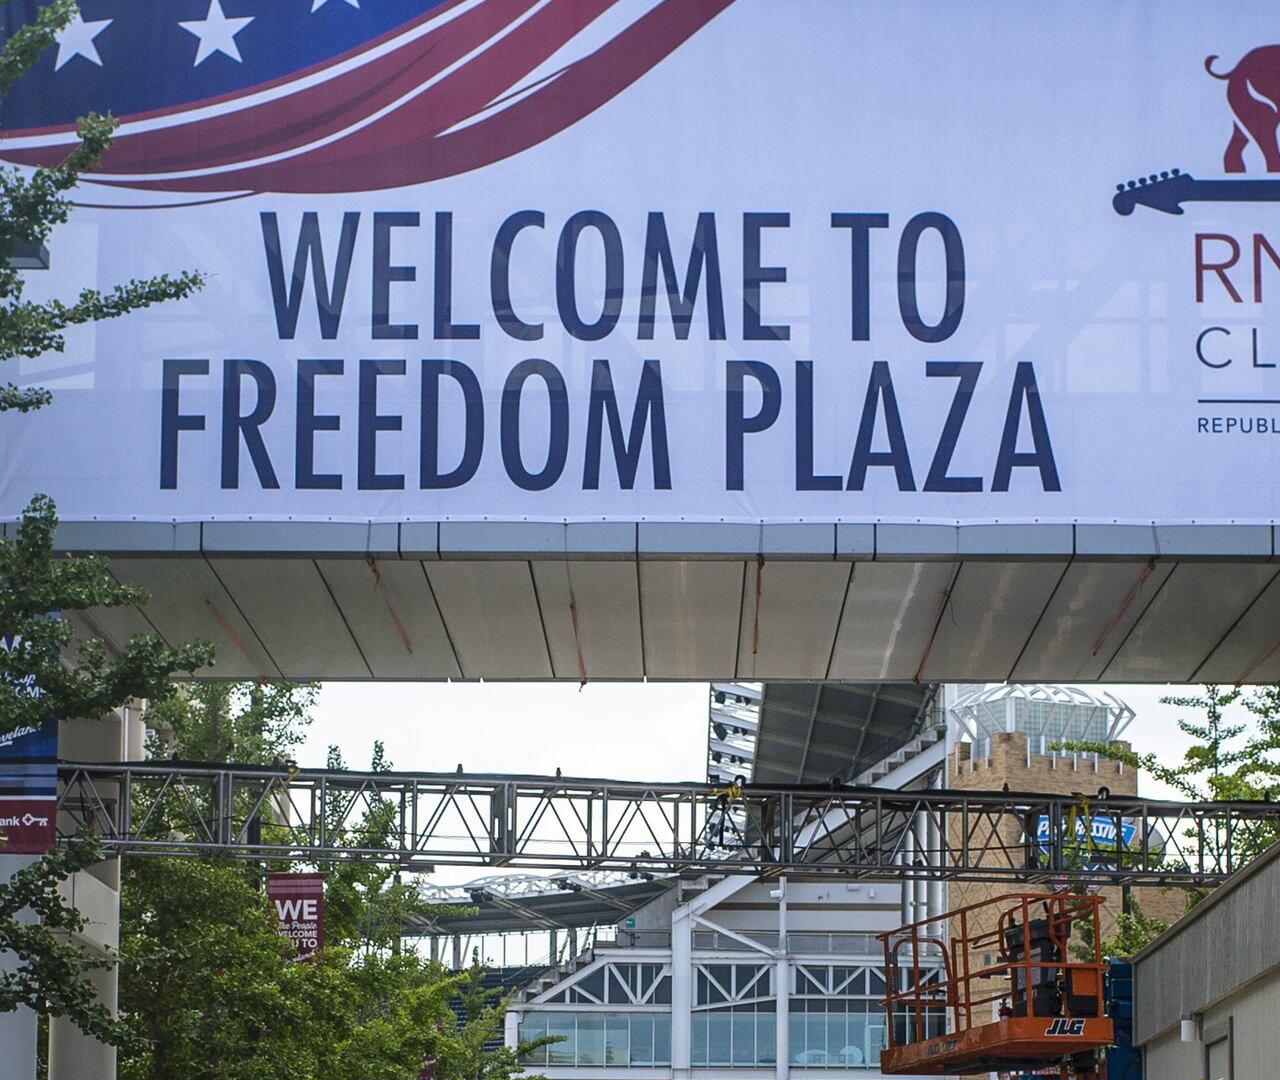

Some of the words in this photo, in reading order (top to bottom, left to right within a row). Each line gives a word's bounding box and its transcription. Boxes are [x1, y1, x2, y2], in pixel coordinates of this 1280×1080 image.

[260, 210, 791, 341] WELCOME
[831, 212, 966, 343] TO
[160, 358, 673, 491] FREEDOM
[726, 361, 1062, 493] PLAZA
[274, 899, 318, 921] WE
[302, 938, 318, 948] TO
[1045, 1018, 1087, 1036] JLG
